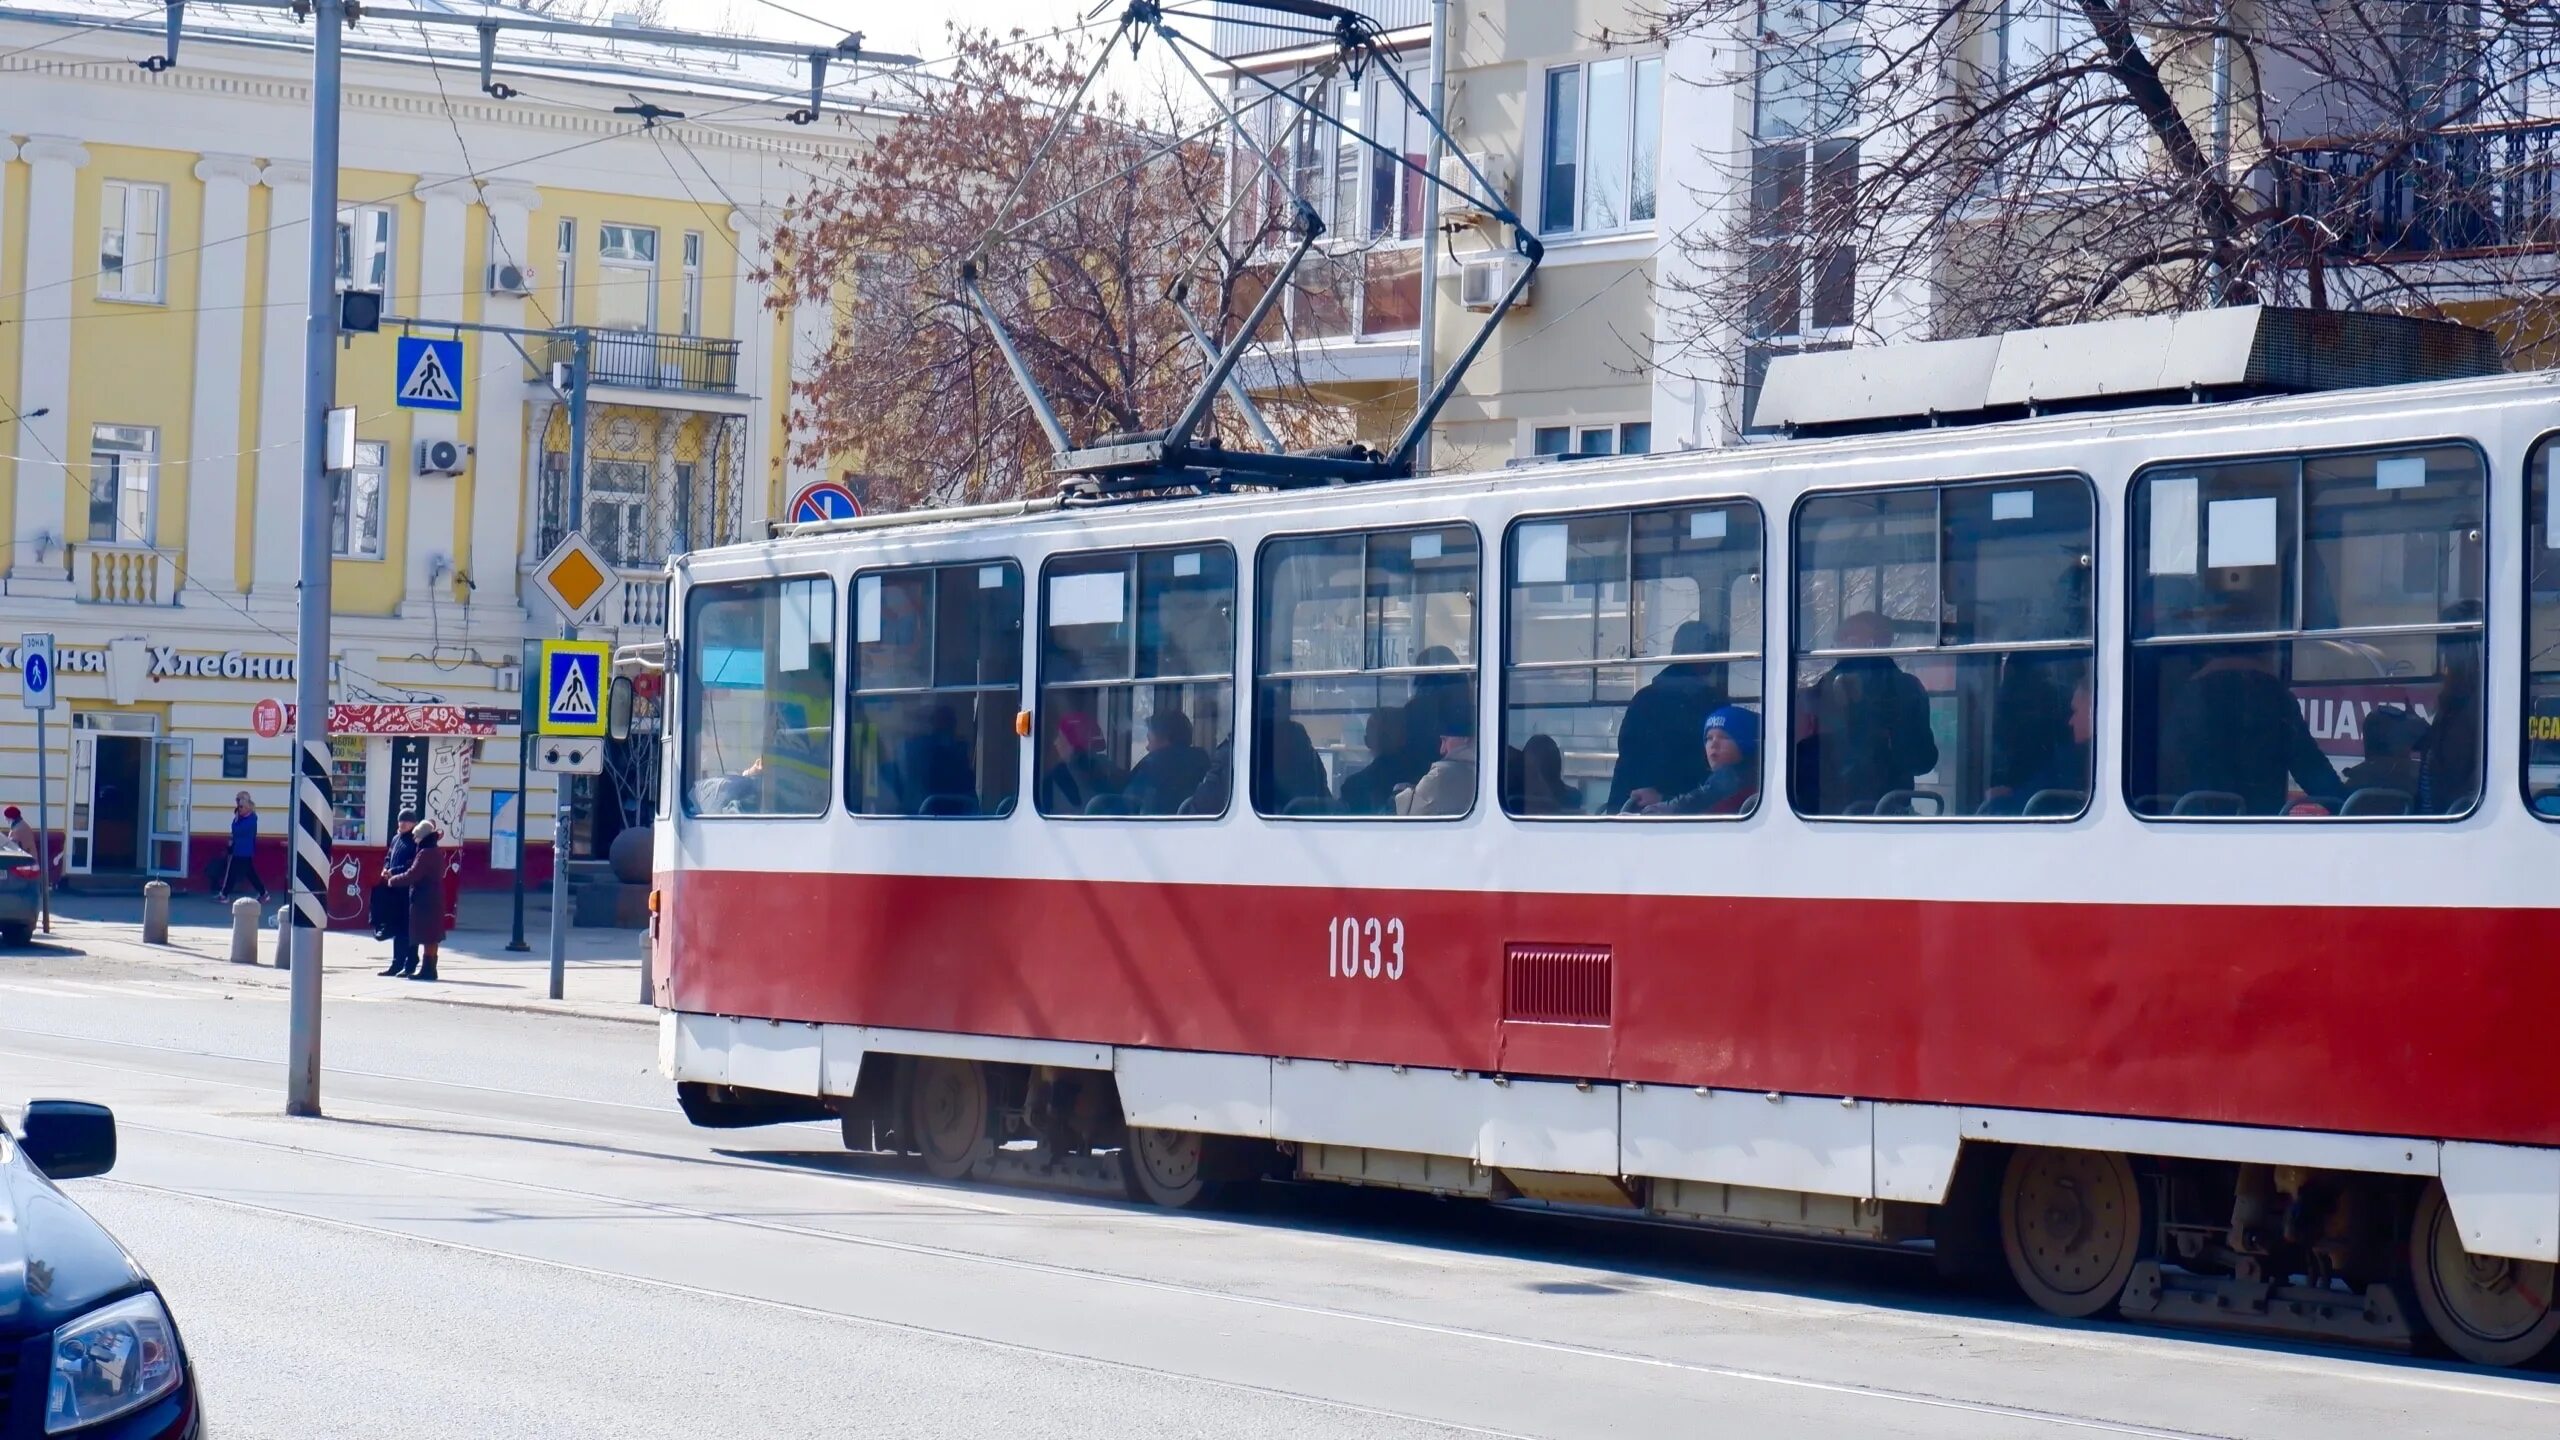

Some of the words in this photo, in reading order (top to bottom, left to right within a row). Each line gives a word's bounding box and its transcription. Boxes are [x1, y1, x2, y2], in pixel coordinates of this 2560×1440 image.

[27, 638, 44, 648] ЗОНА
[152, 646, 337, 682] Хлебни
[428, 707, 449, 721] 49
[400, 757, 419, 812] COFFEE
[1329, 916, 1405, 981] 1033
